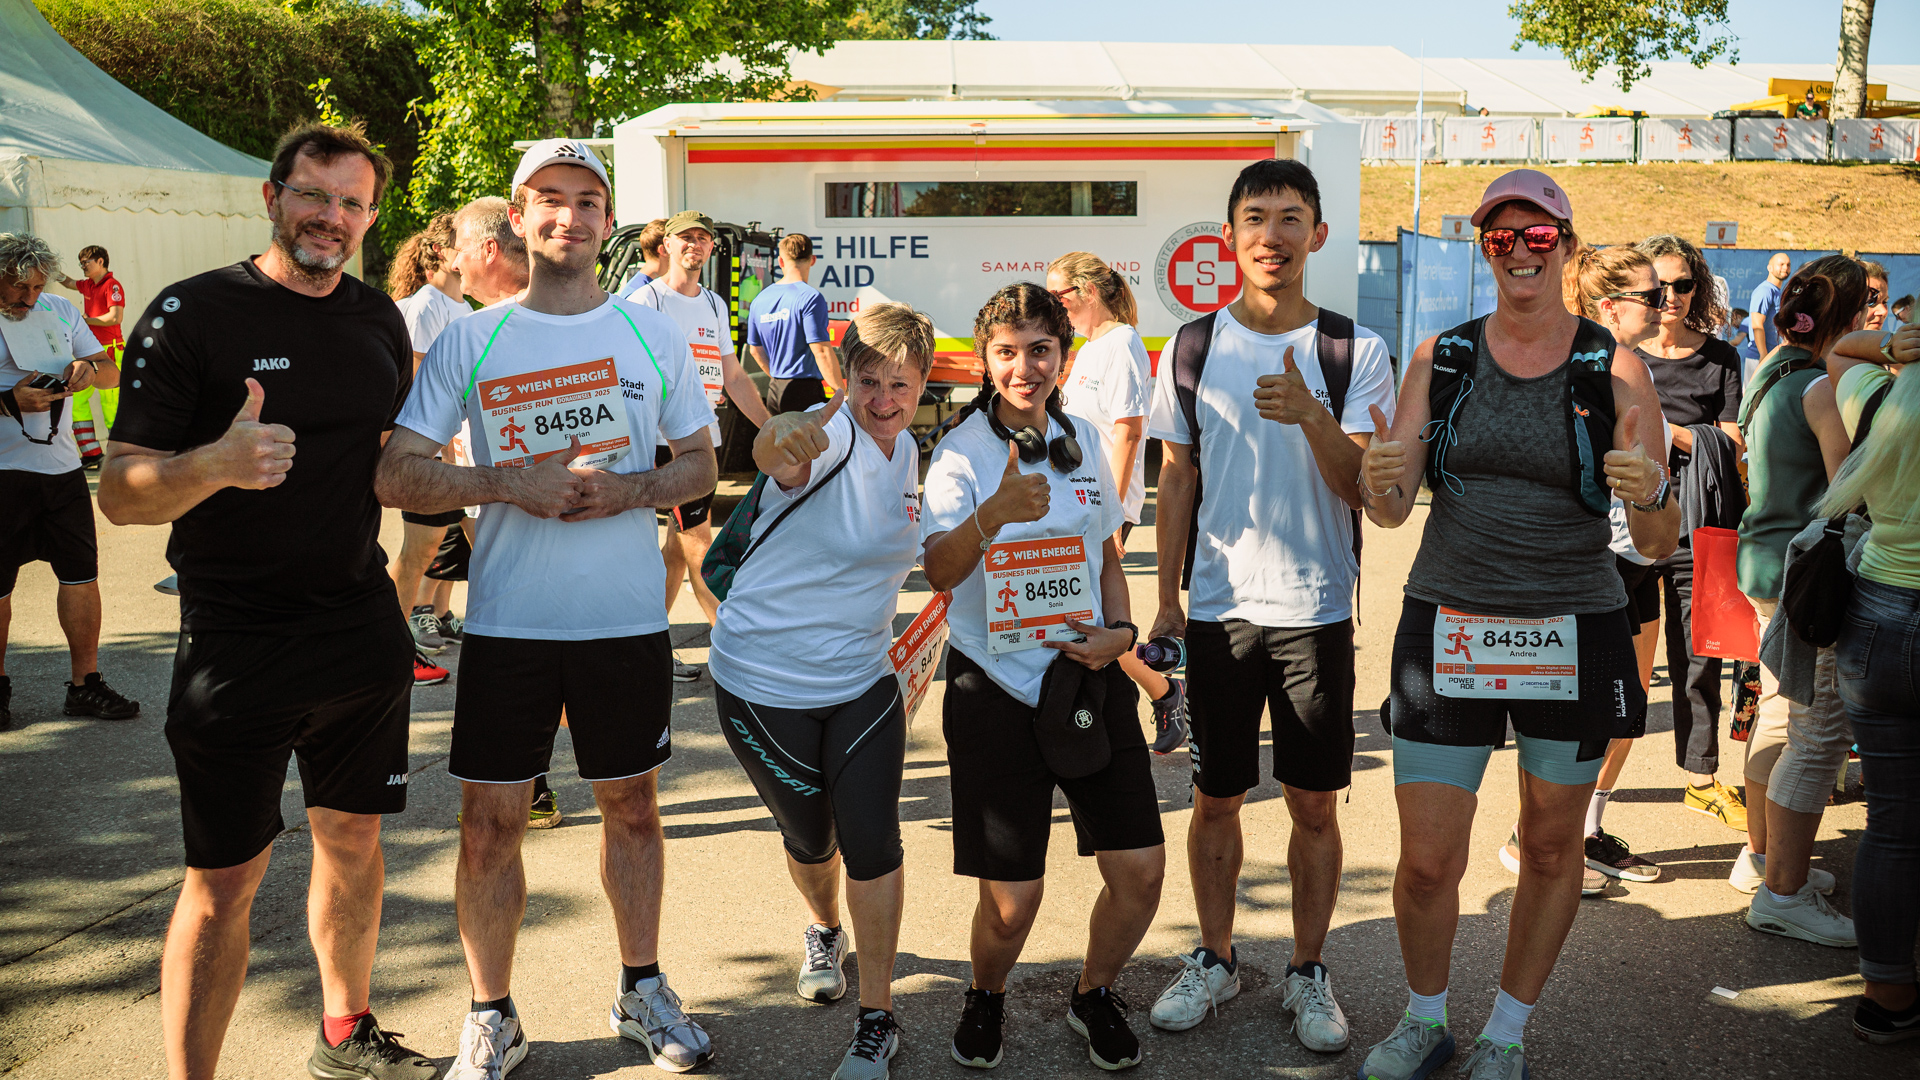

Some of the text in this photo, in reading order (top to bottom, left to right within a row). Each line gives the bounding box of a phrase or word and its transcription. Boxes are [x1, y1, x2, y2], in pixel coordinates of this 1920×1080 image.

[836, 236, 929, 258] HILFE
[1157, 238, 1179, 291] ARBEITER
[1186, 226, 1222, 236] SAMAR
[820, 265, 874, 288] AID
[252, 358, 290, 371] JAKO
[699, 366, 721, 377] 8473A
[516, 369, 610, 394] WIEN ENERGIE
[620, 378, 644, 390] Stadt
[492, 403, 532, 417] BUSINESS
[535, 399, 552, 408] RUN
[594, 389, 610, 397] 2025
[622, 389, 644, 401] Wien
[1315, 389, 1330, 398] Sta
[534, 404, 614, 436] 8458A
[564, 430, 590, 440] Flrian
[1013, 546, 1080, 560] WIEN ENERGIE
[993, 570, 1024, 579] BUSINESS
[1027, 566, 1039, 575] RUN
[1025, 577, 1081, 601] 8458C
[907, 600, 946, 646] WIEN ENERGIE
[1000, 632, 1020, 640] POWER
[1483, 630, 1564, 647] 8453A
[901, 651, 920, 675] BUSINESS
[921, 636, 942, 673] 847
[1618, 680, 1626, 717] SALOMON
[729, 716, 822, 796] DYNAFIT
[386, 773, 408, 785] JAK
